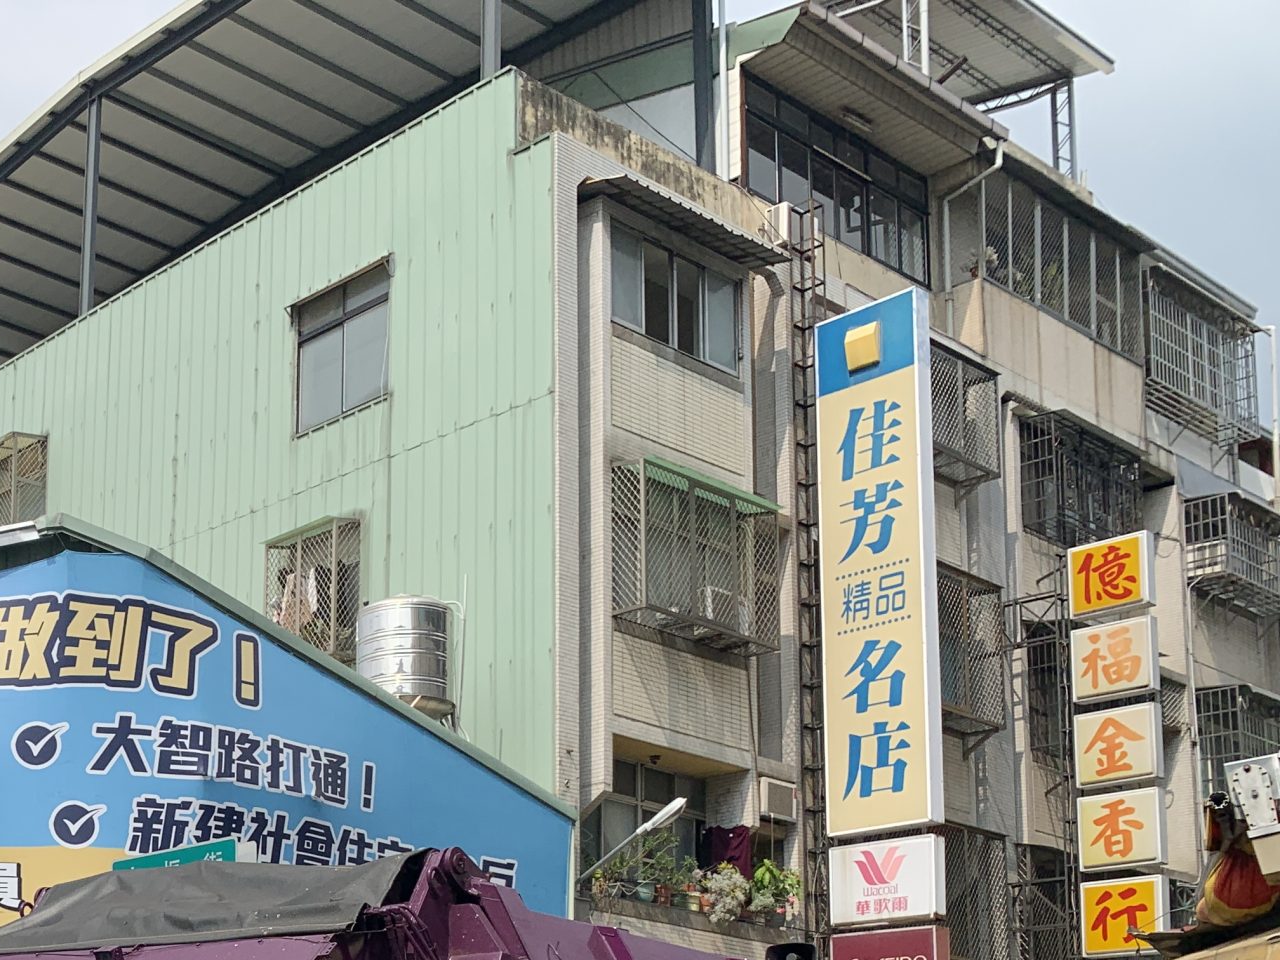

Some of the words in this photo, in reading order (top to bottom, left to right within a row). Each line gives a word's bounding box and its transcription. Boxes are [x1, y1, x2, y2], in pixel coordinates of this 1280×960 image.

[836, 399, 904, 564] 佳芳
[841, 571, 907, 624] 精品
[90, 713, 376, 812] 大智路打通！
[842, 639, 912, 802] 名店
[856, 896, 909, 916] 華歌爾
